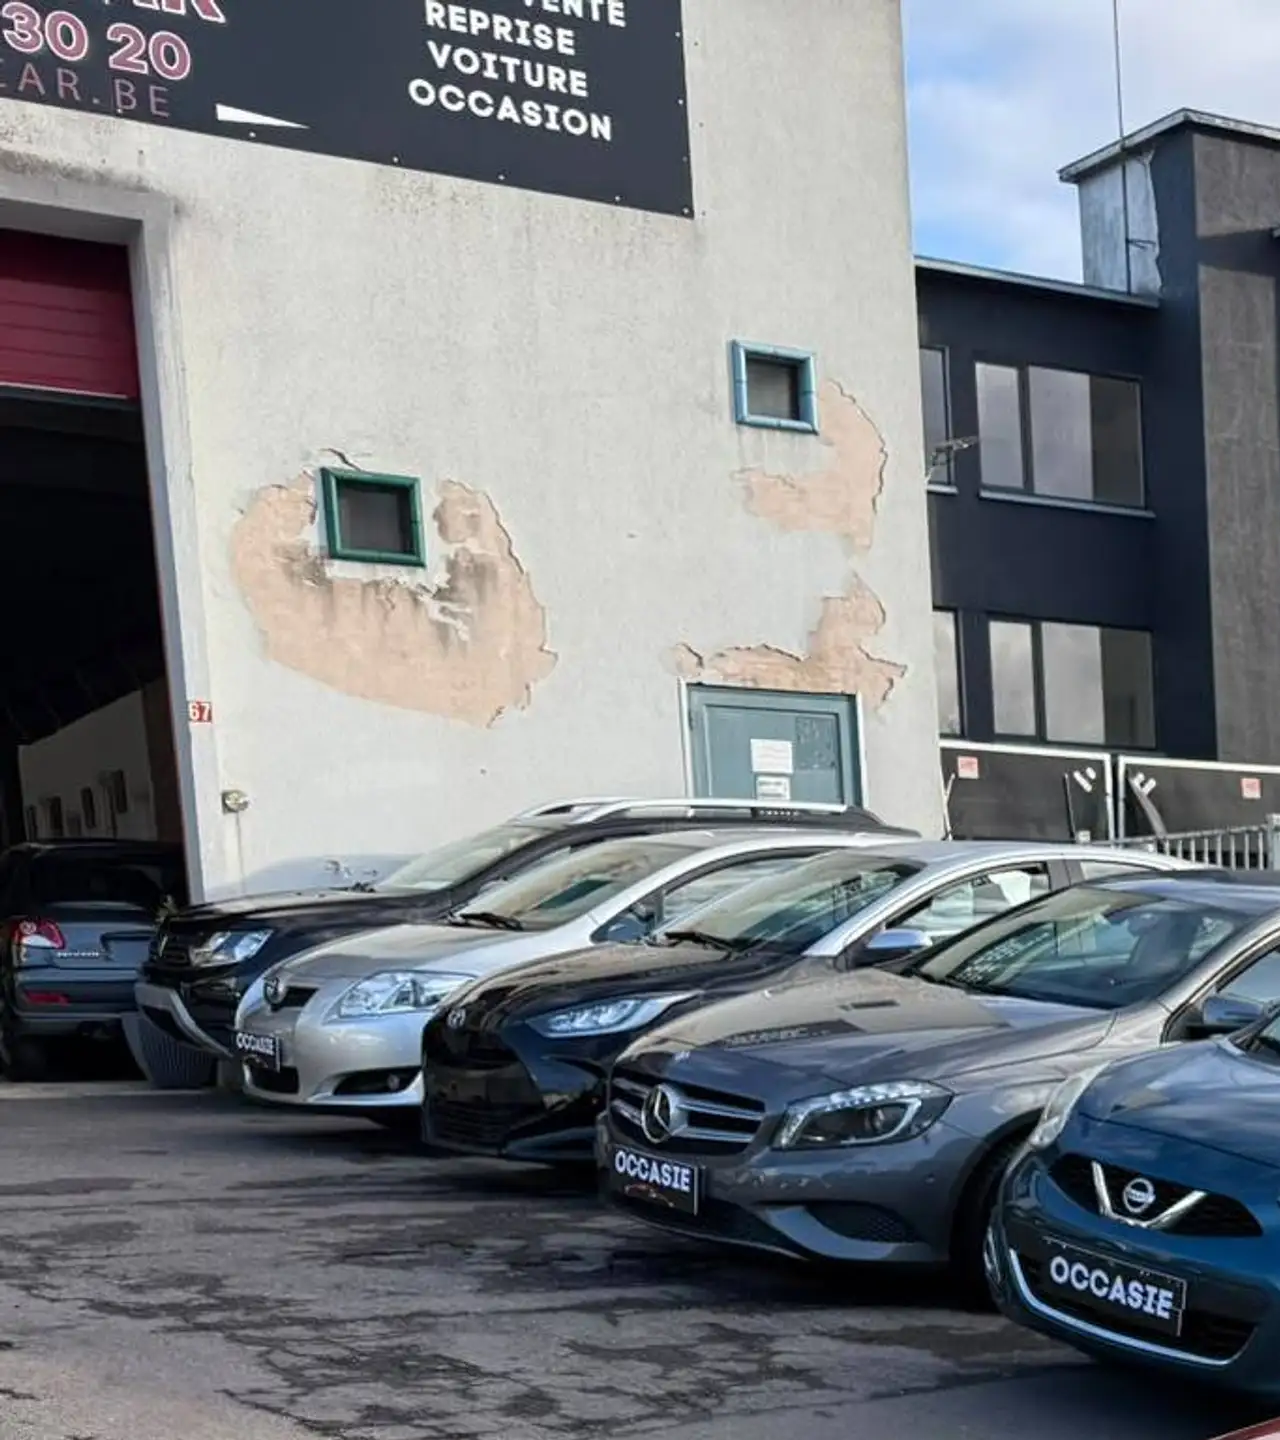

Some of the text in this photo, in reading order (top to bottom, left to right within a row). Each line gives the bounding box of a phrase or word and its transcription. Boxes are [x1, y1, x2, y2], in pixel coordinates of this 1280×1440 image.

[1, 1, 89, 61] 30
[106, 22, 192, 81] 20
[424, 0, 576, 56] REPRISE
[0, 56, 171, 118] AR.BE
[426, 40, 589, 98] VOITURE
[407, 78, 612, 141] OCCASION
[188, 702, 211, 721] 67
[614, 1149, 691, 1193] OCCASIE
[1050, 1255, 1174, 1320] OCCASIE
